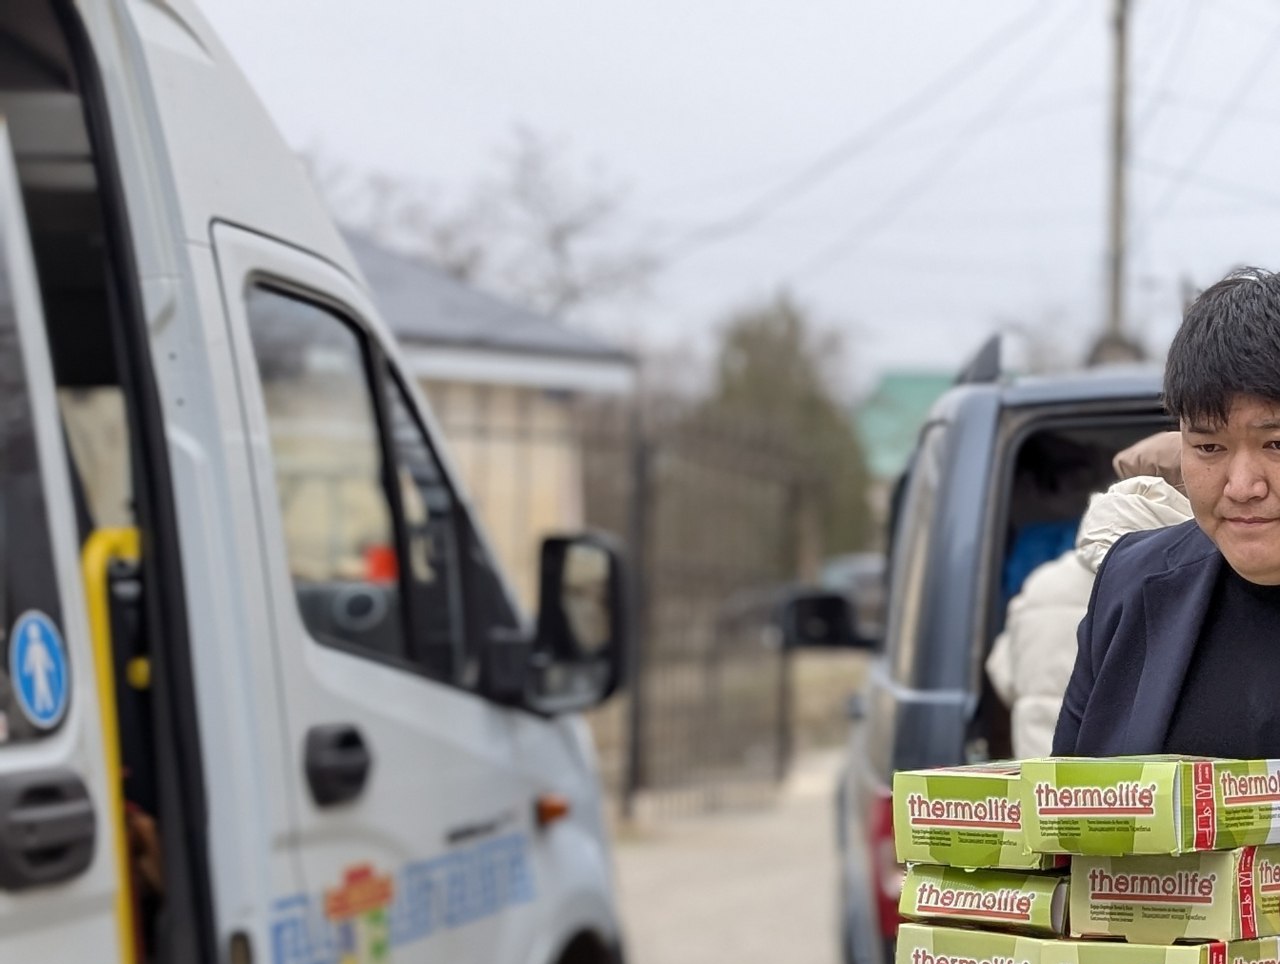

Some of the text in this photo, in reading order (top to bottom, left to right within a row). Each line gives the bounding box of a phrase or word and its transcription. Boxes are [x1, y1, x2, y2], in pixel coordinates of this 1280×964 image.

[909, 794, 1021, 822] thermolife
[1036, 783, 1157, 808] thermolife
[1089, 869, 1217, 896] thermolife
[918, 883, 1035, 913] thermolife
